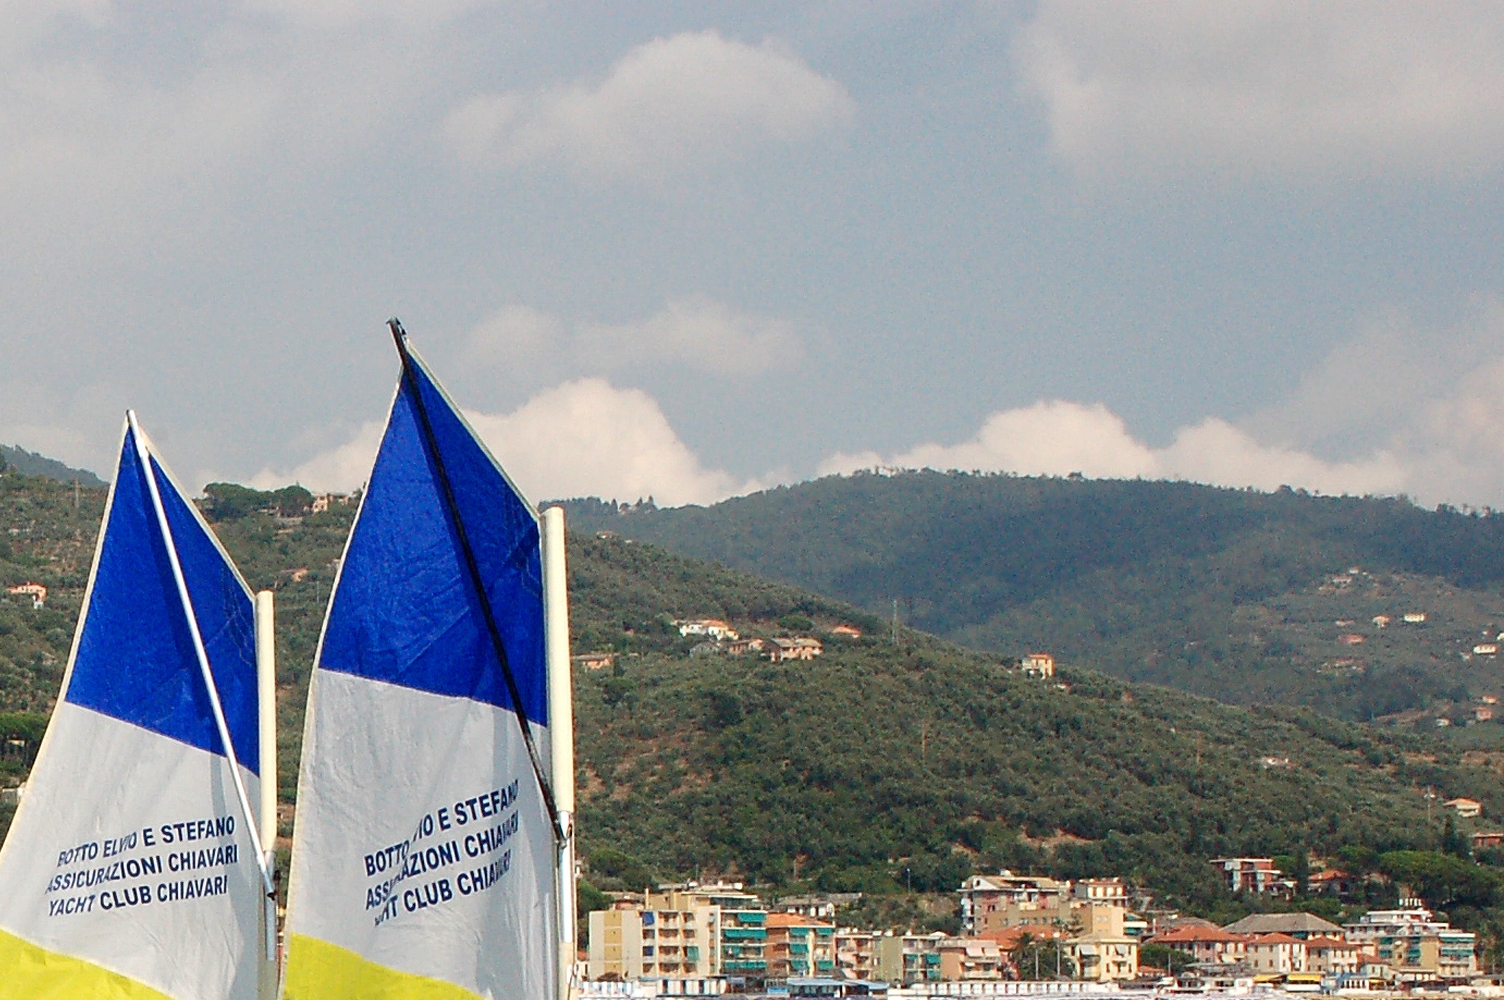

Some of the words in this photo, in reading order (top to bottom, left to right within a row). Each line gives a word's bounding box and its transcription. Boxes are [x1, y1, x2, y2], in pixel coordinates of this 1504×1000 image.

[57, 842, 98, 867] BOTTO
[103, 831, 137, 858] ELVIO
[143, 828, 155, 846] E
[161, 816, 235, 843] STEFANO
[364, 840, 410, 877] BOTTO
[438, 807, 451, 831] E
[45, 855, 163, 894] ASSICURAZIONI
[168, 844, 238, 872] CHIAVARI
[48, 894, 96, 916] YACHT
[100, 885, 152, 910] CLUB
[157, 875, 227, 902] CHIAVARI
[403, 879, 453, 912] CLUB
